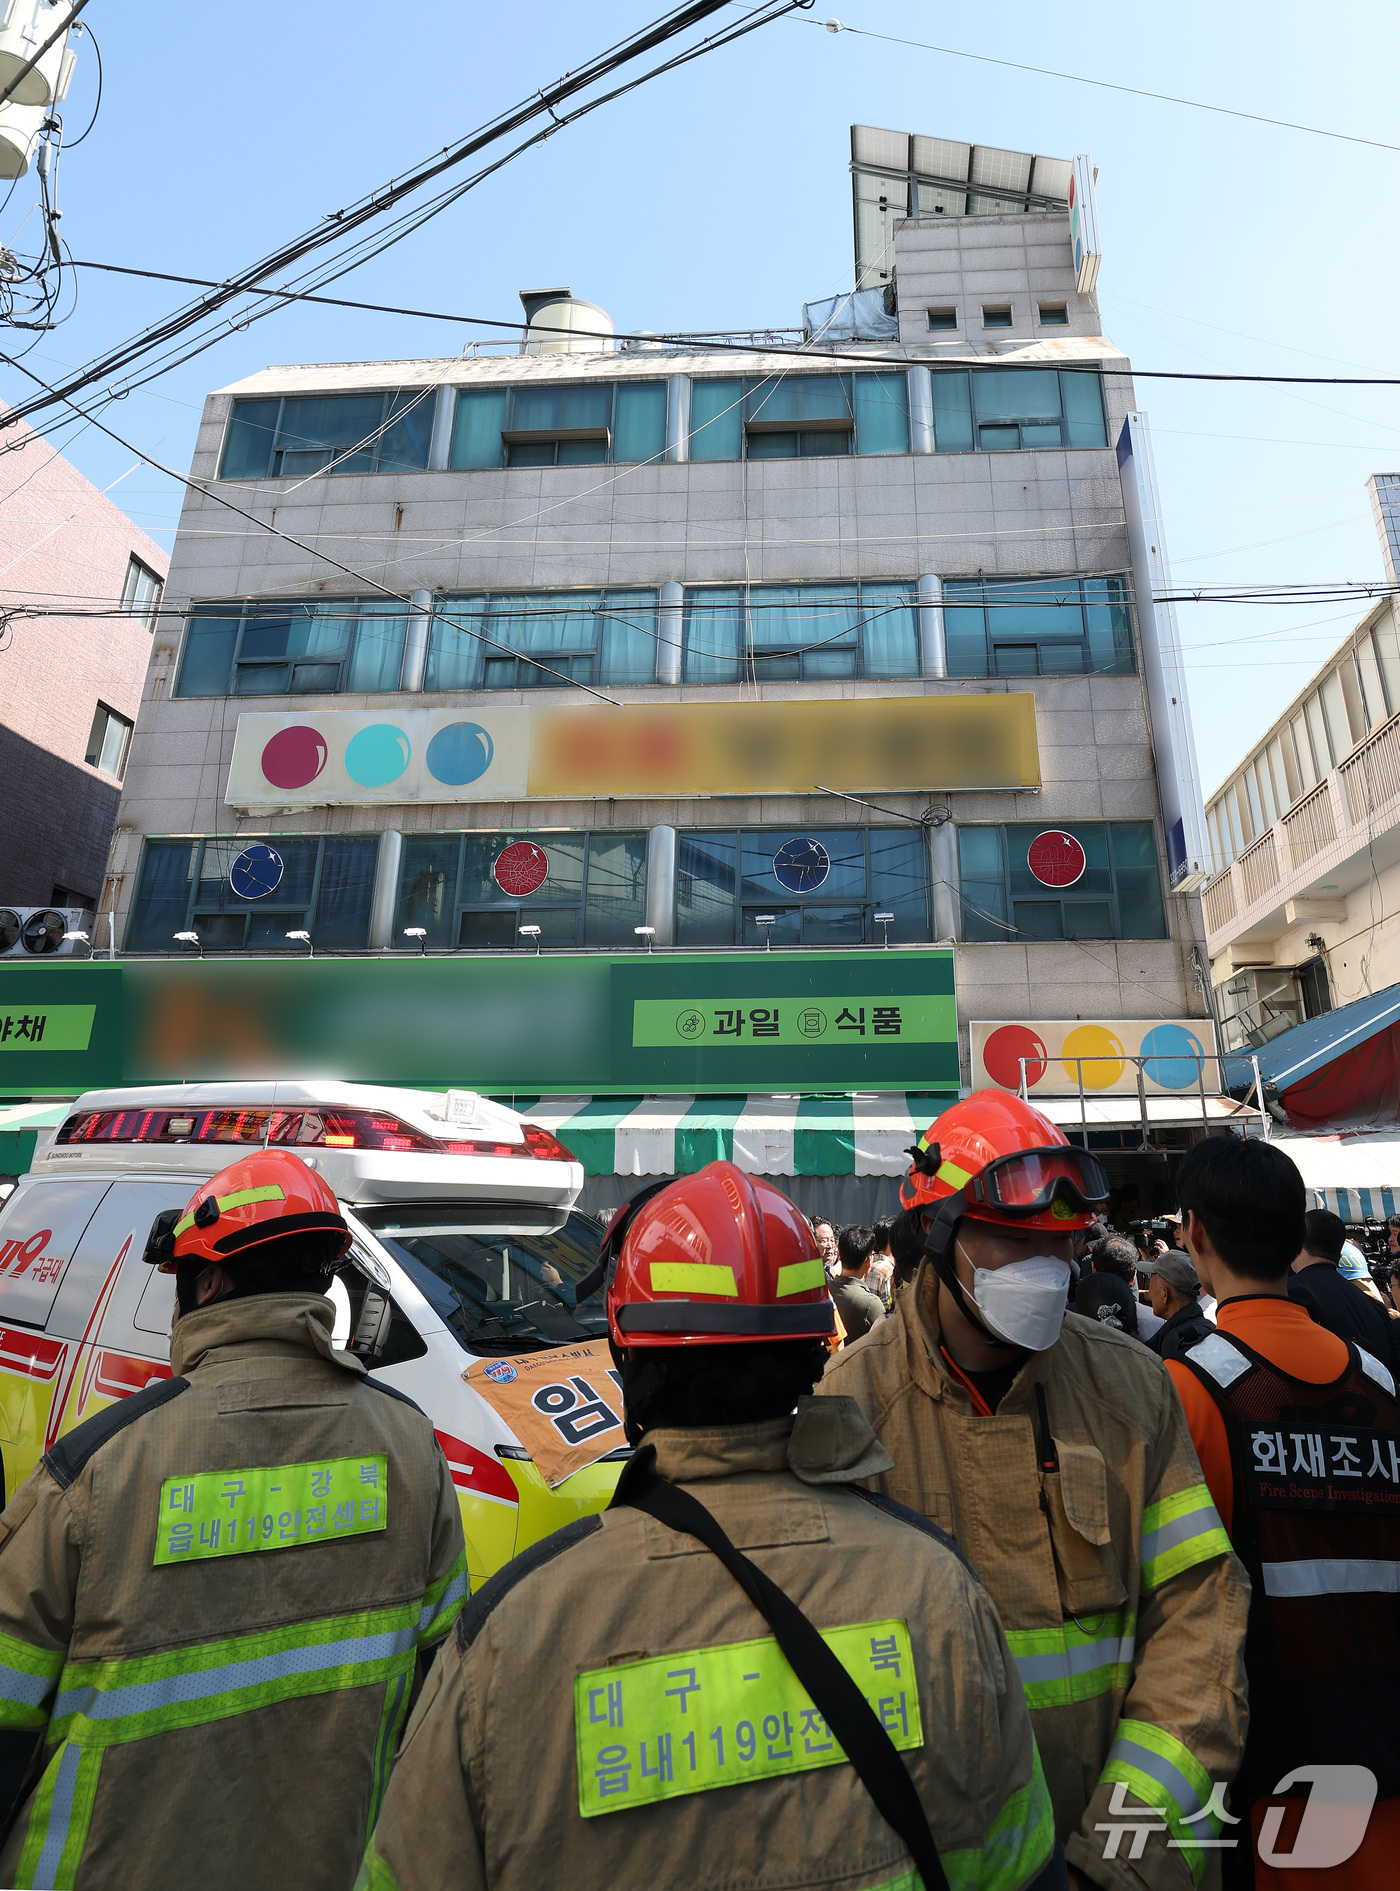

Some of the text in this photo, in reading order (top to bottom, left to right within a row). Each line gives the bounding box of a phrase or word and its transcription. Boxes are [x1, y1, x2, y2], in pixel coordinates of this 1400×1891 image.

[713, 1006, 902, 1037] 과일 식품
[32, 1257, 64, 1284] 구급대
[491, 1364, 512, 1378] 119
[1251, 1430, 1400, 1483] 화재조사
[1259, 1482, 1400, 1504] Fire Scene Investigation
[168, 1496, 379, 1554] 읍내119안전센터
[595, 1691, 909, 1798] 읍내119안전터
